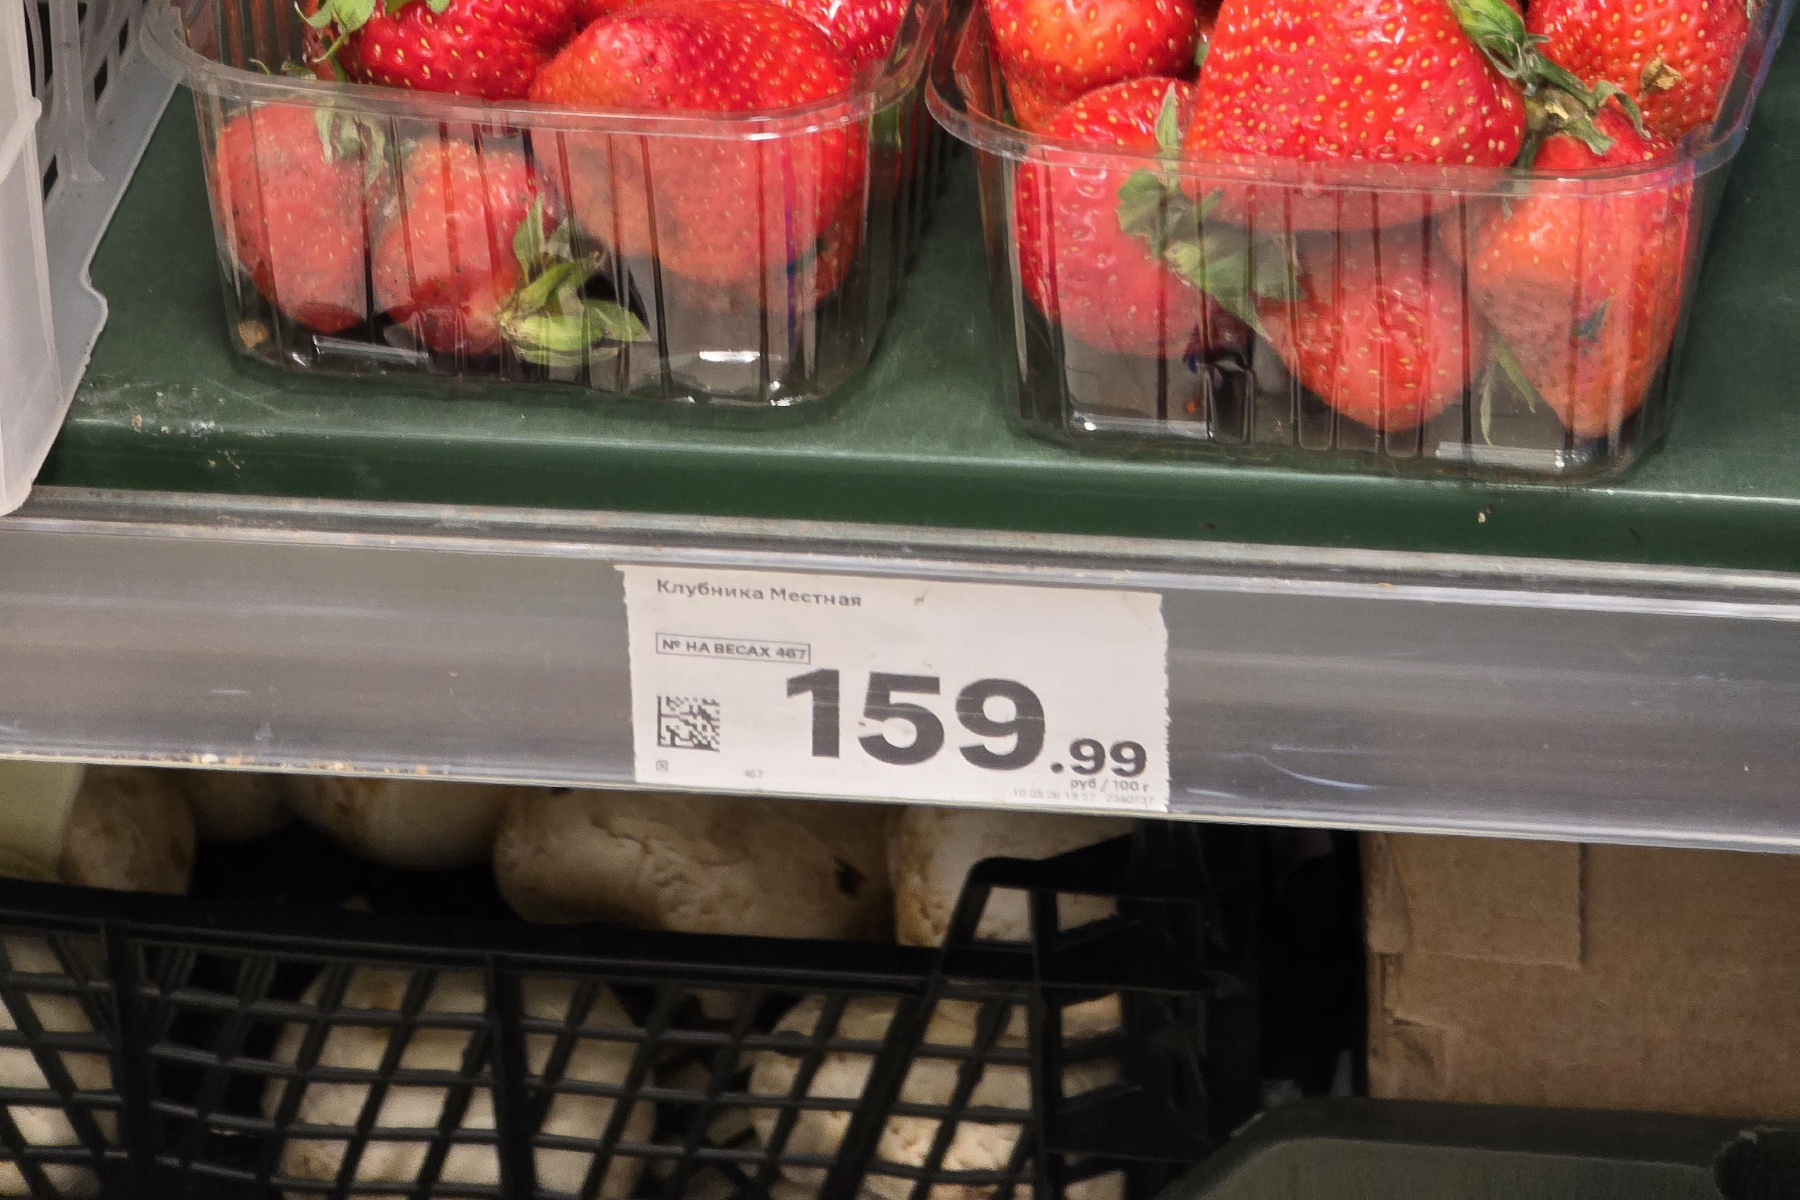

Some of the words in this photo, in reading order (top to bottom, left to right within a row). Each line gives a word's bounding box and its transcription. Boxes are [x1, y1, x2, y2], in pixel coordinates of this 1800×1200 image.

[656, 578, 764, 600] Клубника
[770, 587, 862, 607] Местная
[686, 641, 711, 654] НА
[714, 643, 771, 658] ВЕСАХ
[775, 646, 807, 660] 467
[1070, 778, 1097, 791] руб
[1113, 780, 1139, 792] 100
